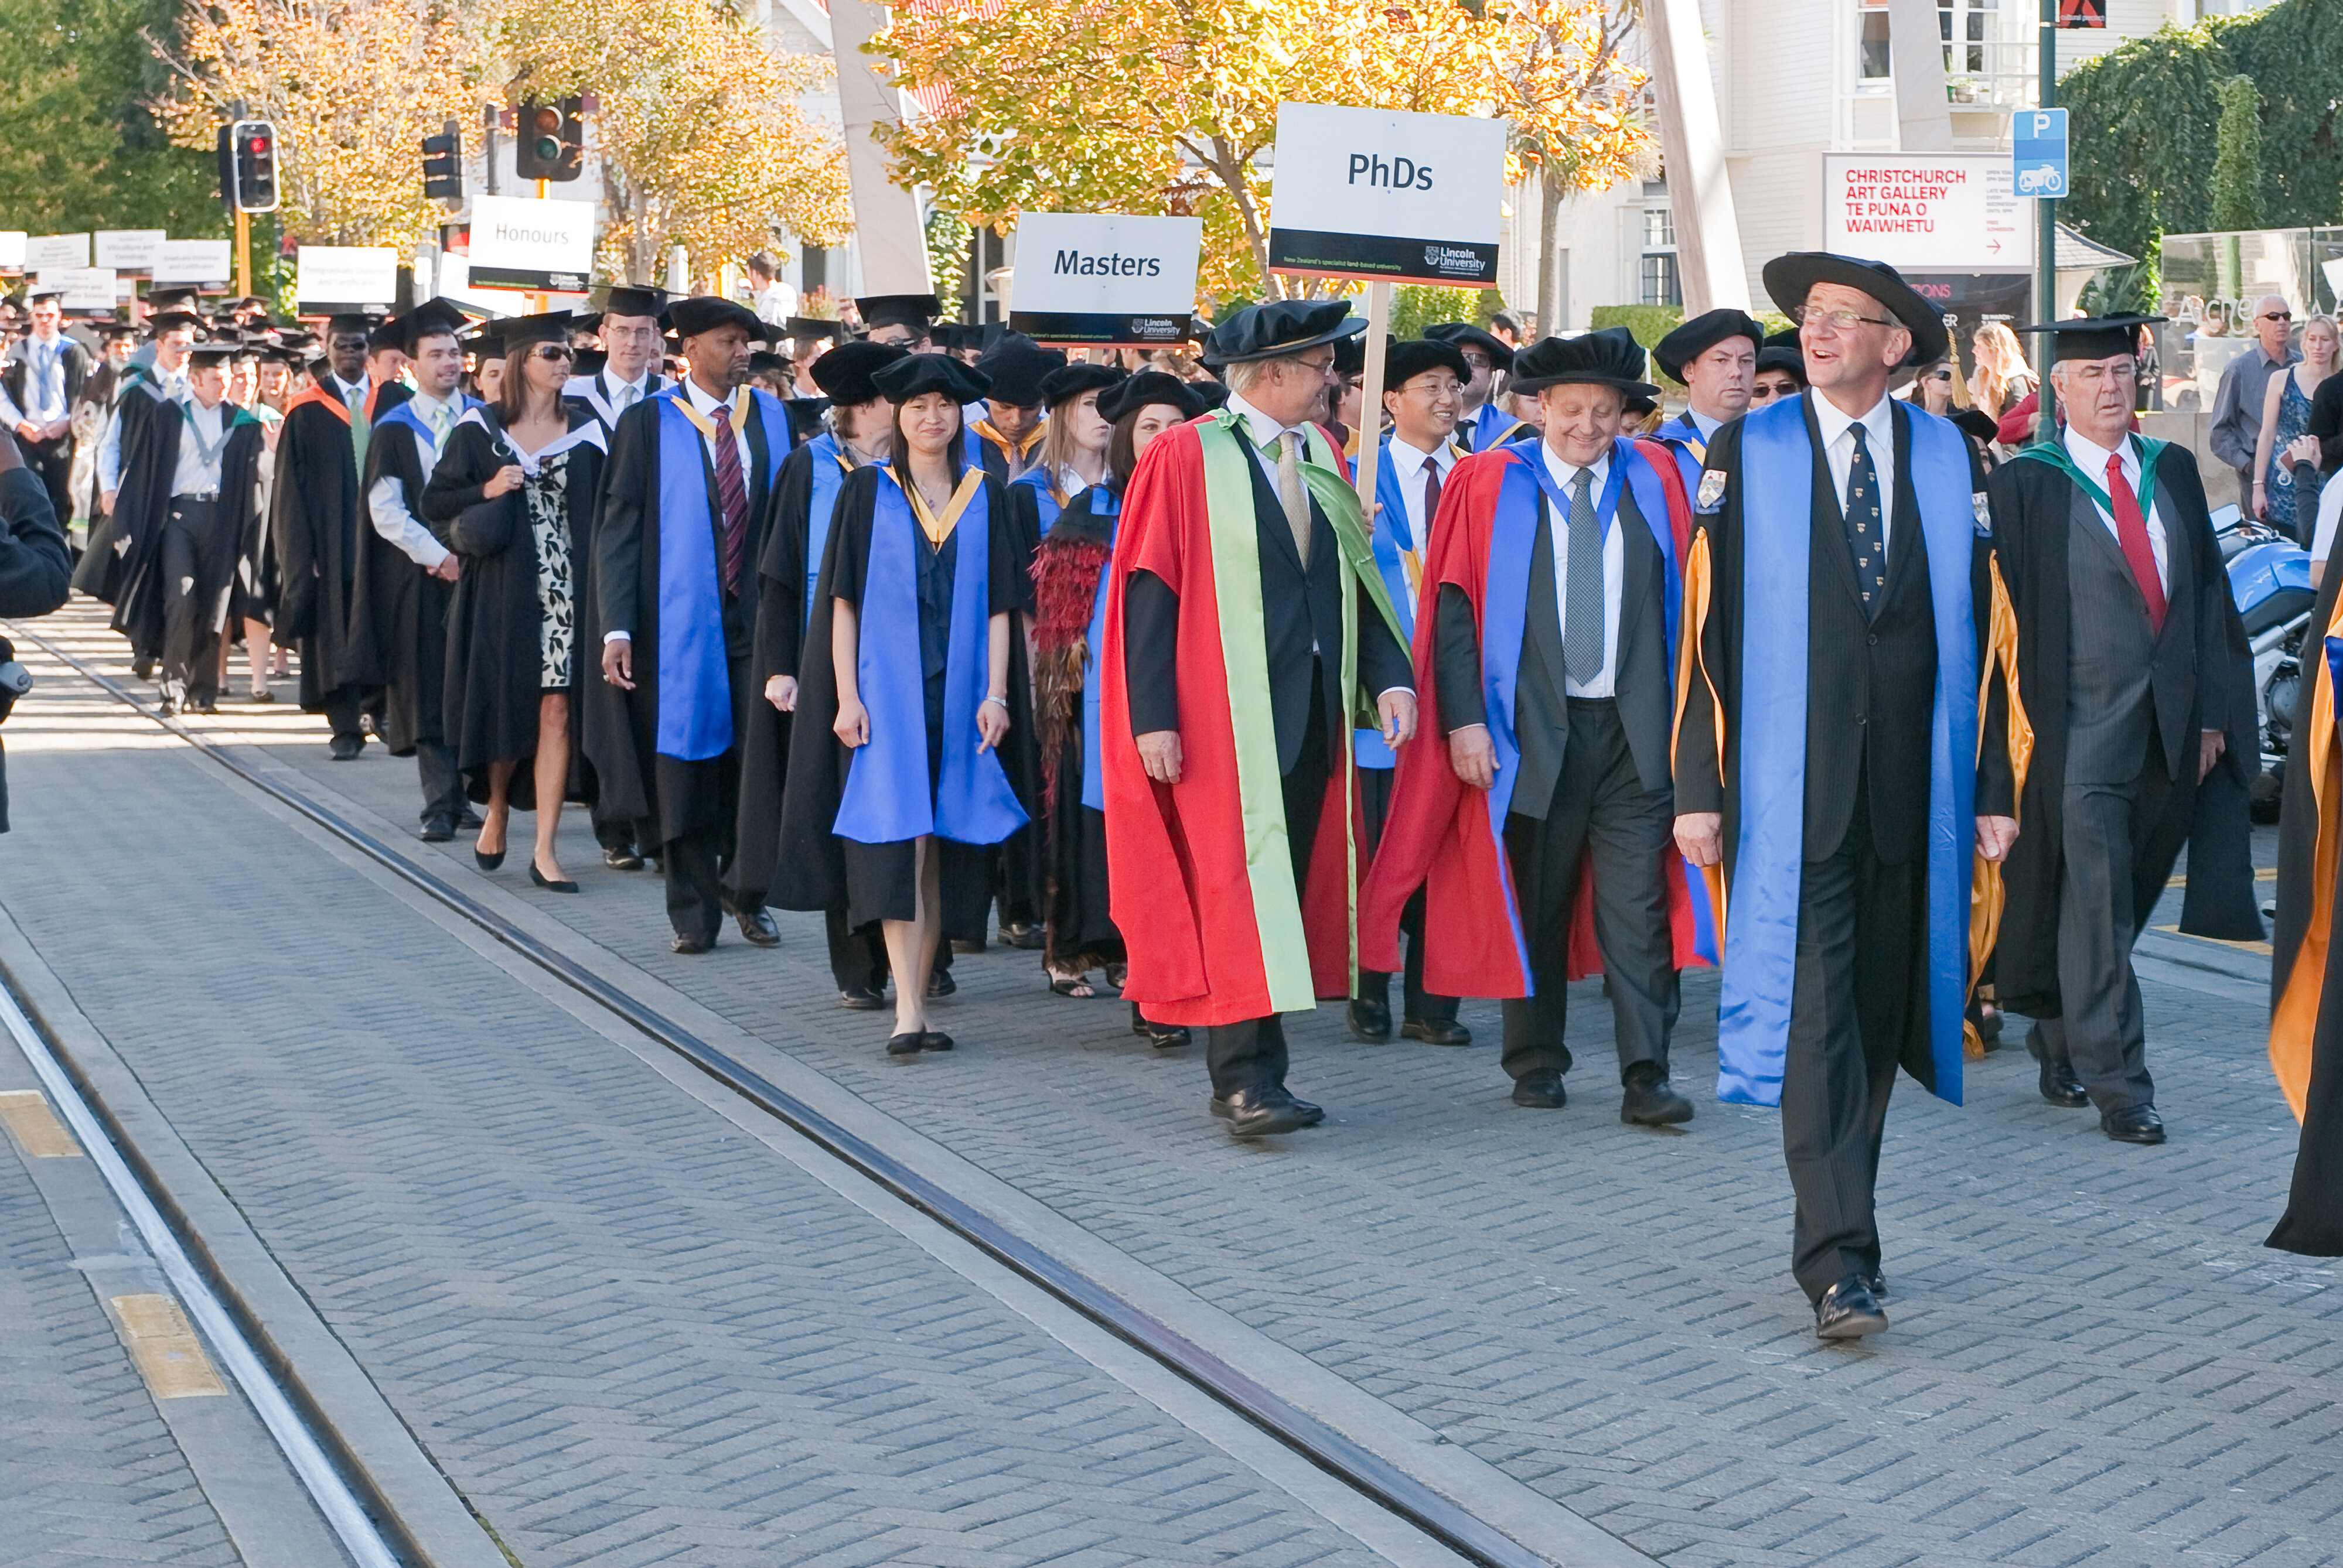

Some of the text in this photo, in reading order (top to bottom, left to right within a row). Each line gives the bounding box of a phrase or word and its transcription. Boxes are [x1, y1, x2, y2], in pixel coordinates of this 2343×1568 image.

[2033, 114, 2051, 138] P
[1348, 153, 1433, 191] PhDs
[1846, 170, 1966, 183] CHRISTCHURCH
[1846, 186, 1948, 200] ART GALLERY
[1846, 203, 1927, 216] TE PUNA O
[1846, 219, 1934, 233] WAIWHETU
[496, 223, 569, 245] Honours
[1441, 246, 1475, 259] Lincoln
[1054, 250, 1160, 276] Masters
[1440, 257, 1486, 271] University
[1144, 318, 1172, 326] Lincoln
[1144, 326, 1181, 335] University
